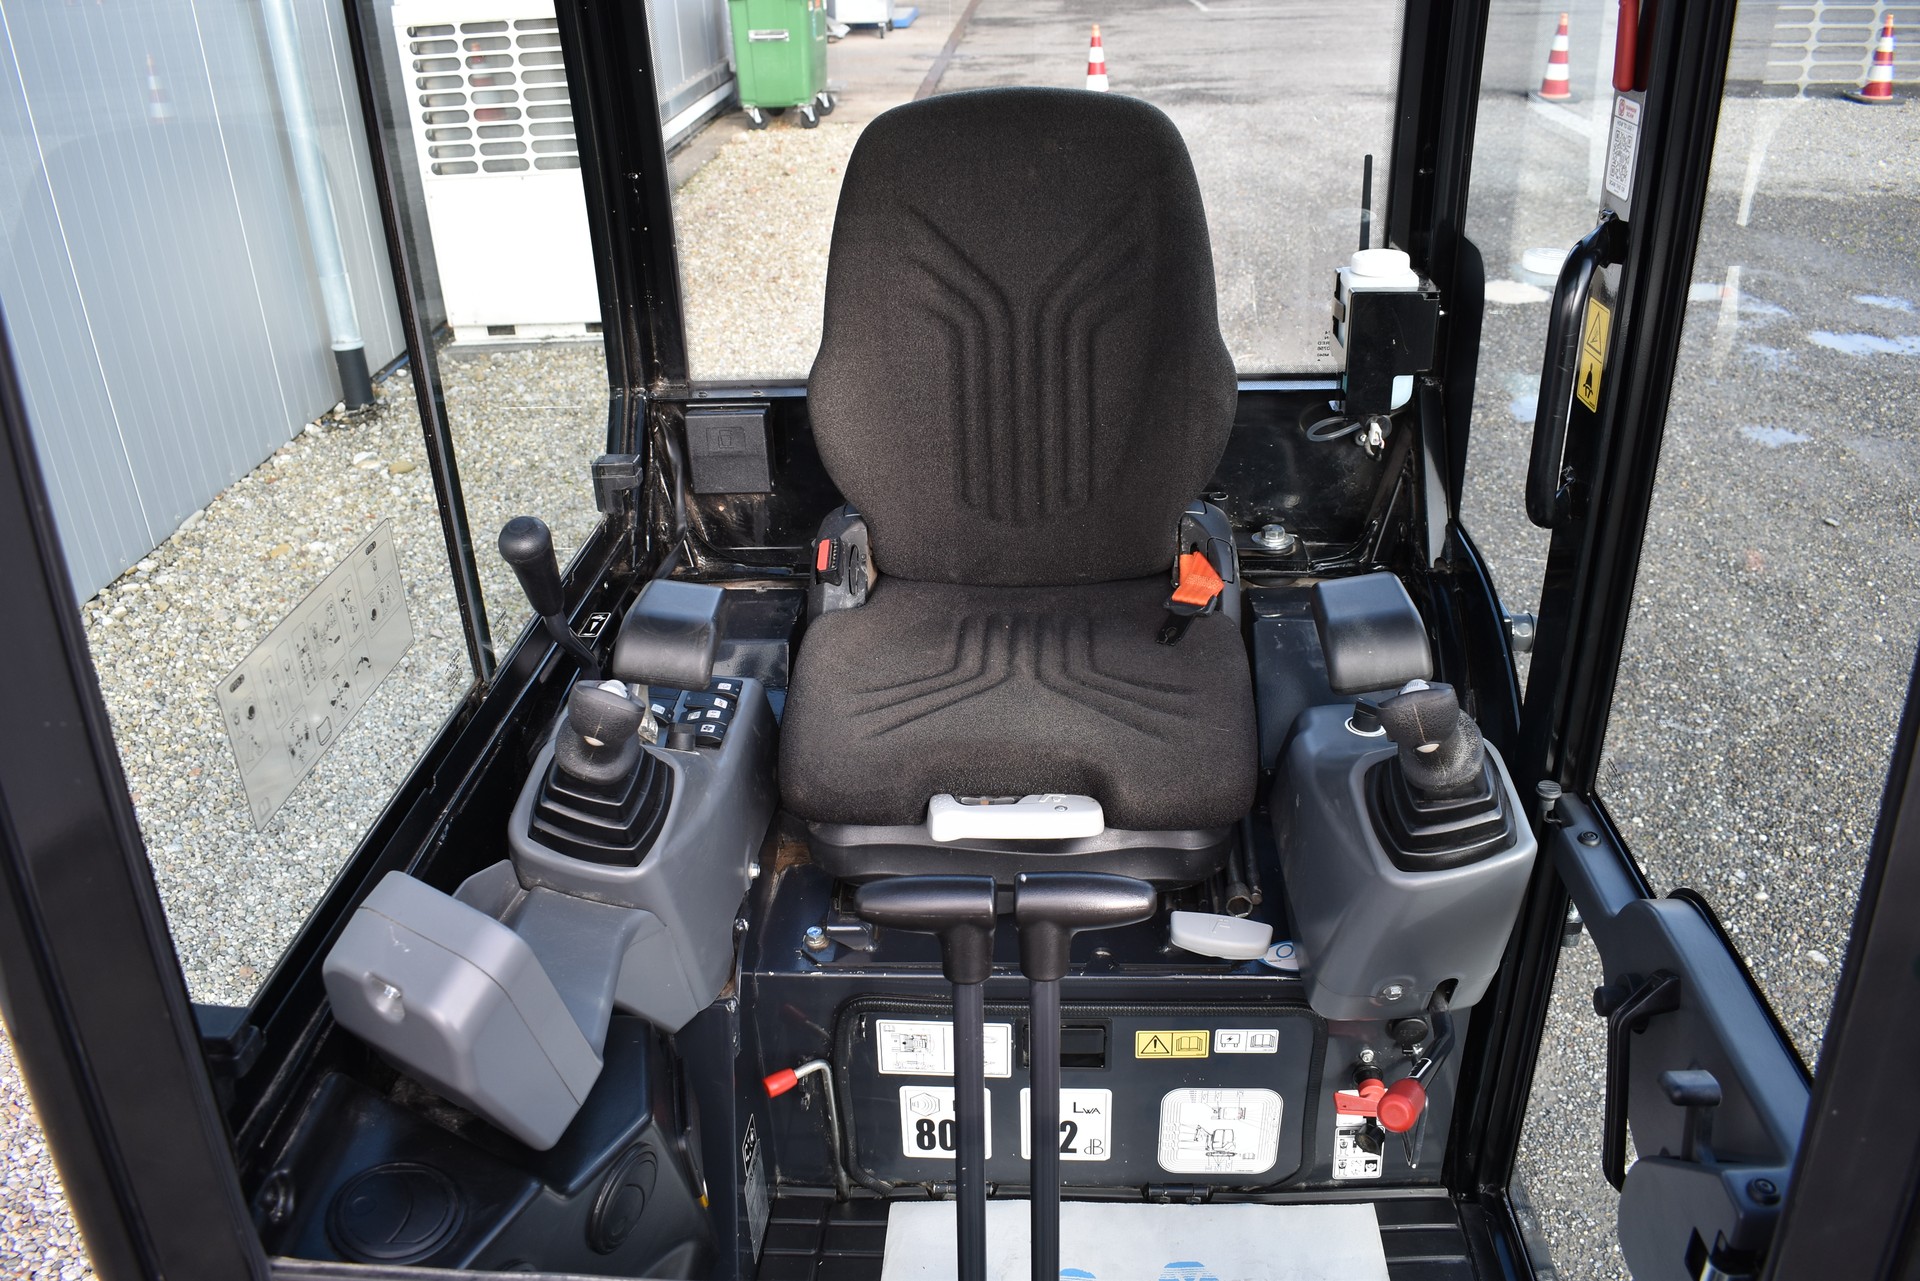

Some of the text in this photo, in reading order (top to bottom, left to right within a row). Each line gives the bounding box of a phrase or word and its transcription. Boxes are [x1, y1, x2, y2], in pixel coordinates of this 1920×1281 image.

[916, 1119, 956, 1151] 80
[1060, 1120, 1104, 1155] 2 dB
